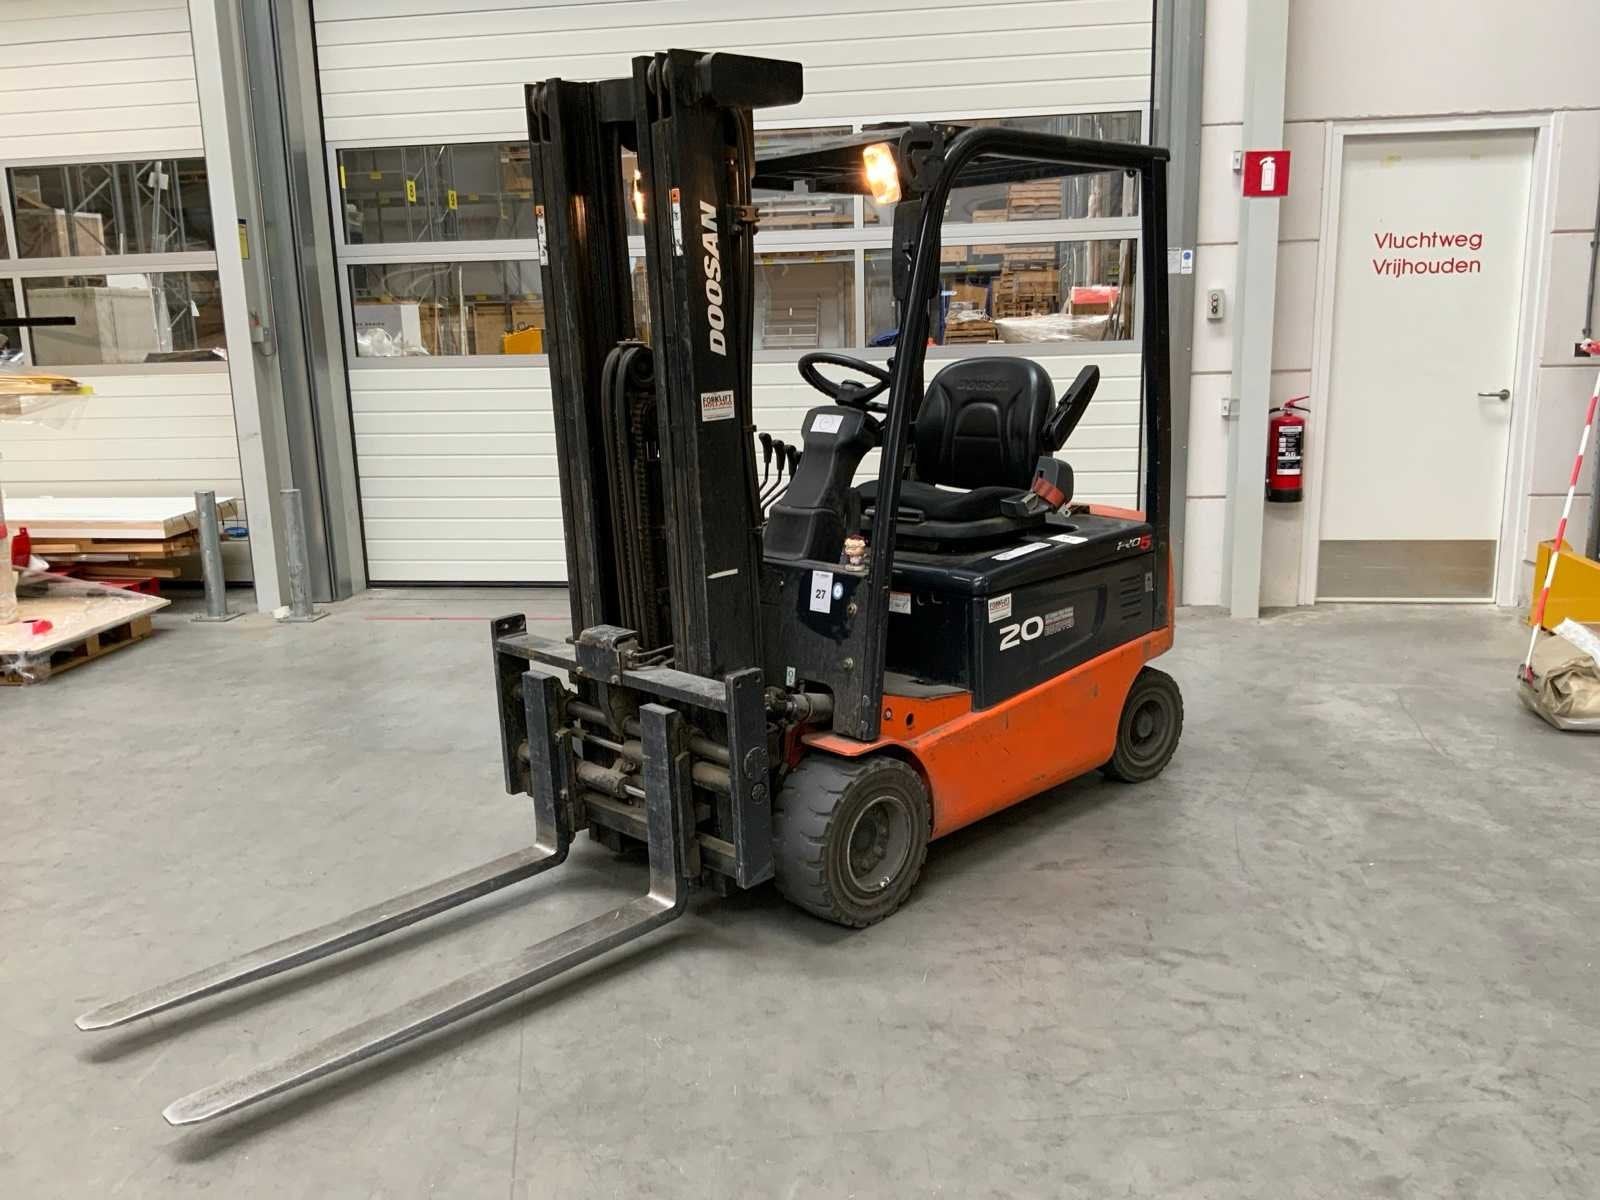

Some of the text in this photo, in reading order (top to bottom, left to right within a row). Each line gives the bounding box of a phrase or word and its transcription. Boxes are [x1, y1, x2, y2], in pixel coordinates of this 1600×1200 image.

[1374, 232, 1482, 250] Vluchtweg
[1373, 257, 1480, 278] Vrijhouden
[700, 200, 727, 357] DOOSAN
[815, 589, 827, 600] 27
[999, 616, 1044, 652] 20
